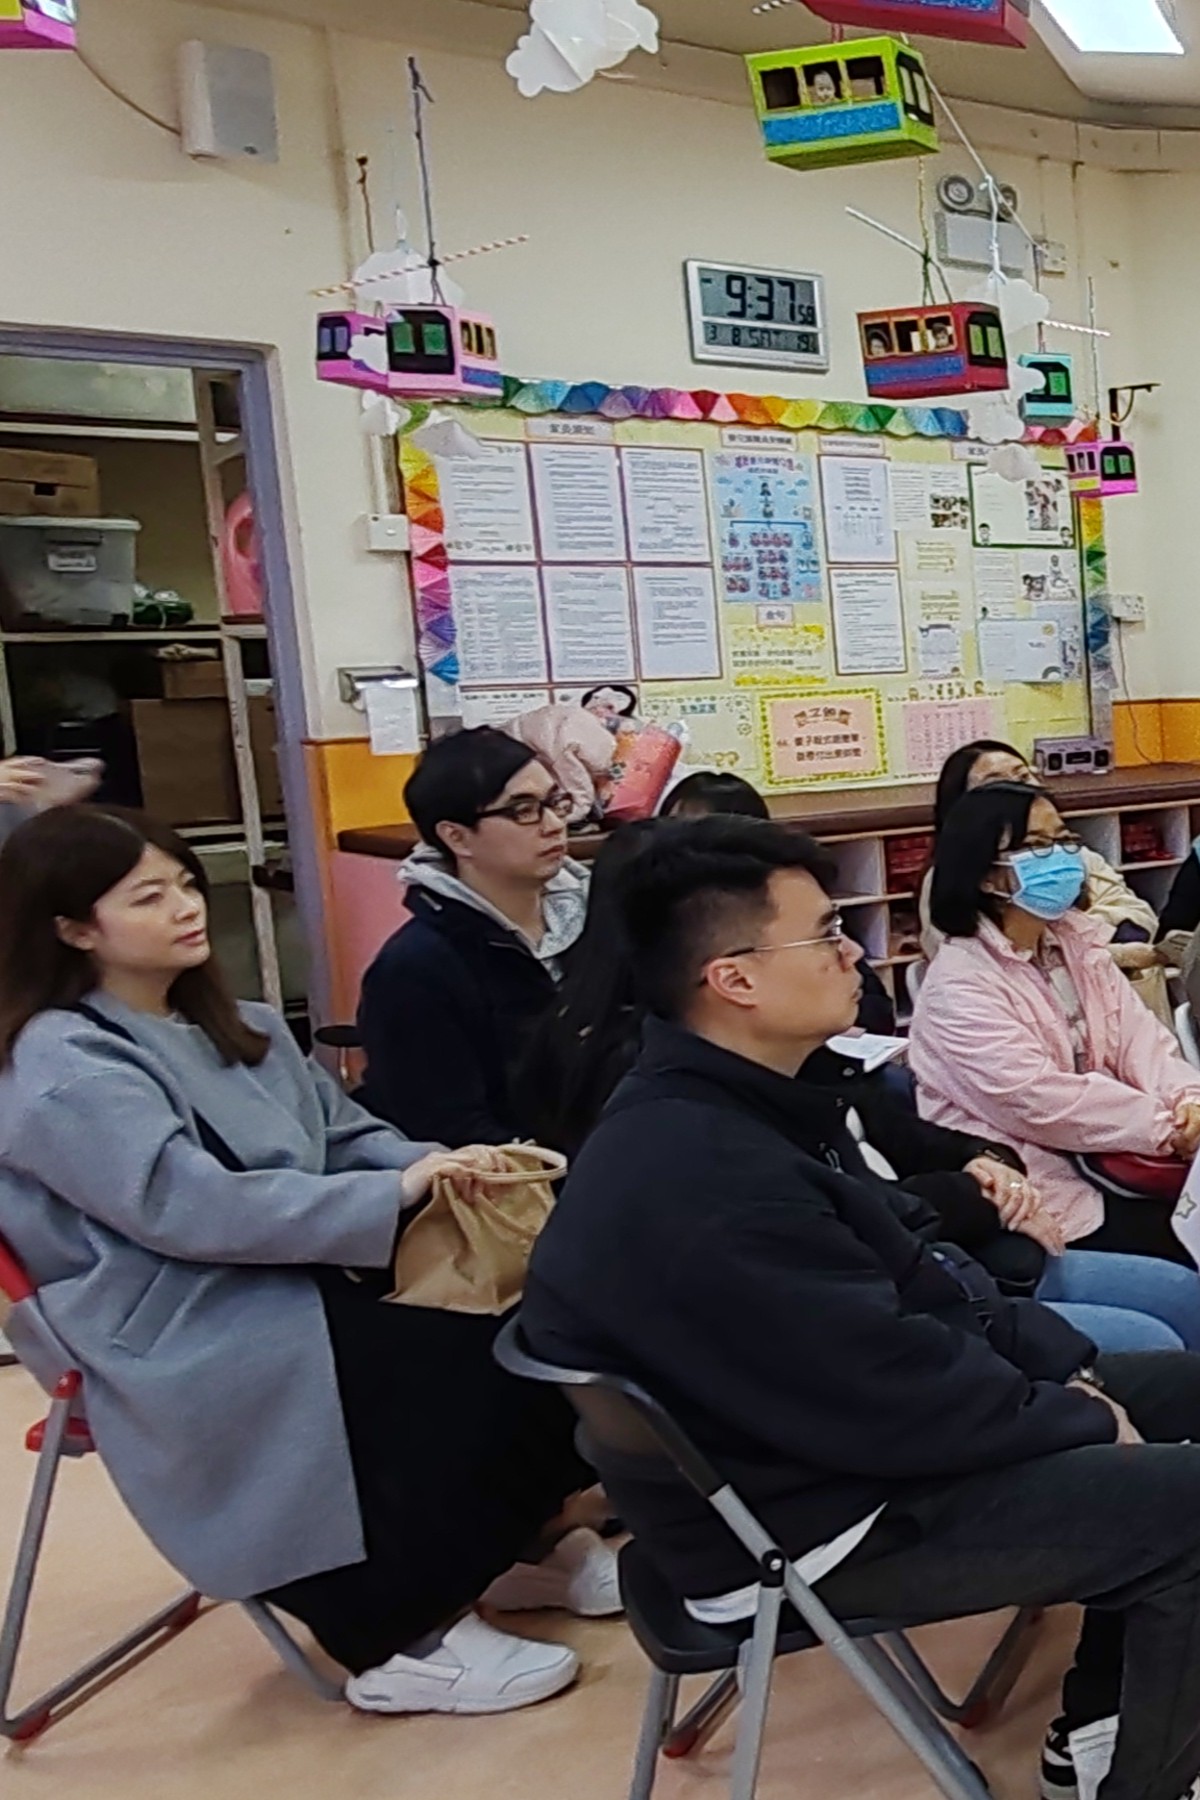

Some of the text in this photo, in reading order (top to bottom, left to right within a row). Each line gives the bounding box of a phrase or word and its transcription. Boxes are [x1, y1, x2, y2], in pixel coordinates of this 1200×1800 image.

[725, 274, 796, 321] 9:37
[709, 324, 718, 341] 3
[731, 326, 742, 346] 8
